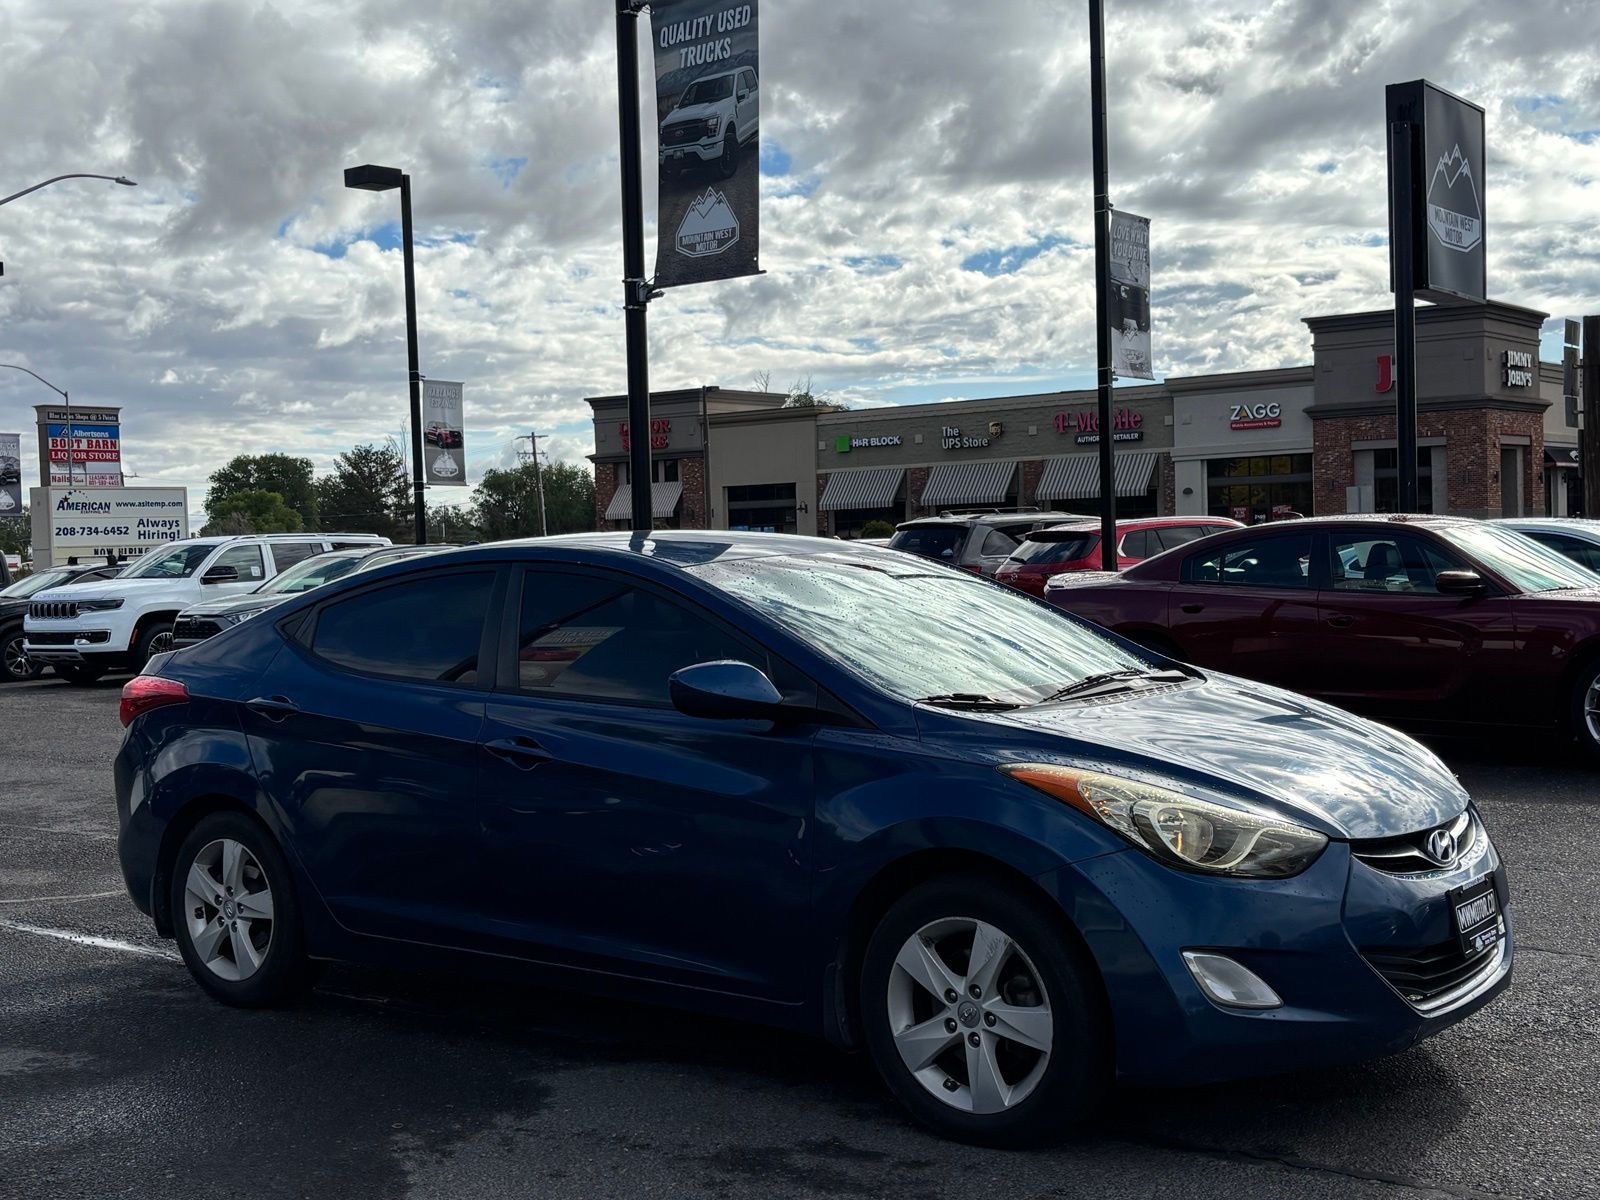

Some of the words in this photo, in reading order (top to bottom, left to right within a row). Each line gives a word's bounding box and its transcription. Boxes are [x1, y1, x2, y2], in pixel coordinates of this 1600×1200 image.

[660, 14, 714, 48] QUALITY
[717, 5, 751, 33] USED
[680, 37, 731, 68] TRUCKS
[1434, 207, 1459, 229] MOUNTAIN
[1459, 214, 1474, 233] WEST
[682, 231, 714, 246] MOUNTAIN
[715, 229, 733, 240] WEST
[1113, 224, 1130, 240] LOVE
[1130, 228, 1148, 245] WHAT
[1445, 227, 1463, 244] MOTOR
[696, 240, 718, 252] MOTOR
[1113, 241, 1128, 257] YOU
[1128, 244, 1148, 261] DRIVE
[1507, 350, 1532, 368] JIMMY
[1507, 369, 1532, 387] JOHN'S
[1230, 403, 1280, 420] ZAGG
[1052, 407, 1143, 433] T-Mile
[73, 430, 109, 438] Albertsons
[942, 426, 960, 437] The
[1113, 432, 1139, 441] RETAILER
[86, 439, 117, 449] BARN
[852, 438, 869, 447] H&R
[870, 435, 901, 446] BLOCK
[942, 438, 961, 449] UPS
[963, 437, 988, 448] Store
[88, 452, 118, 460] STORE
[57, 500, 111, 511] AMERICAN
[137, 518, 180, 530] Always
[55, 526, 130, 536] 208-734-6452
[137, 530, 180, 541] Hiring!
[93, 548, 114, 556] NOW
